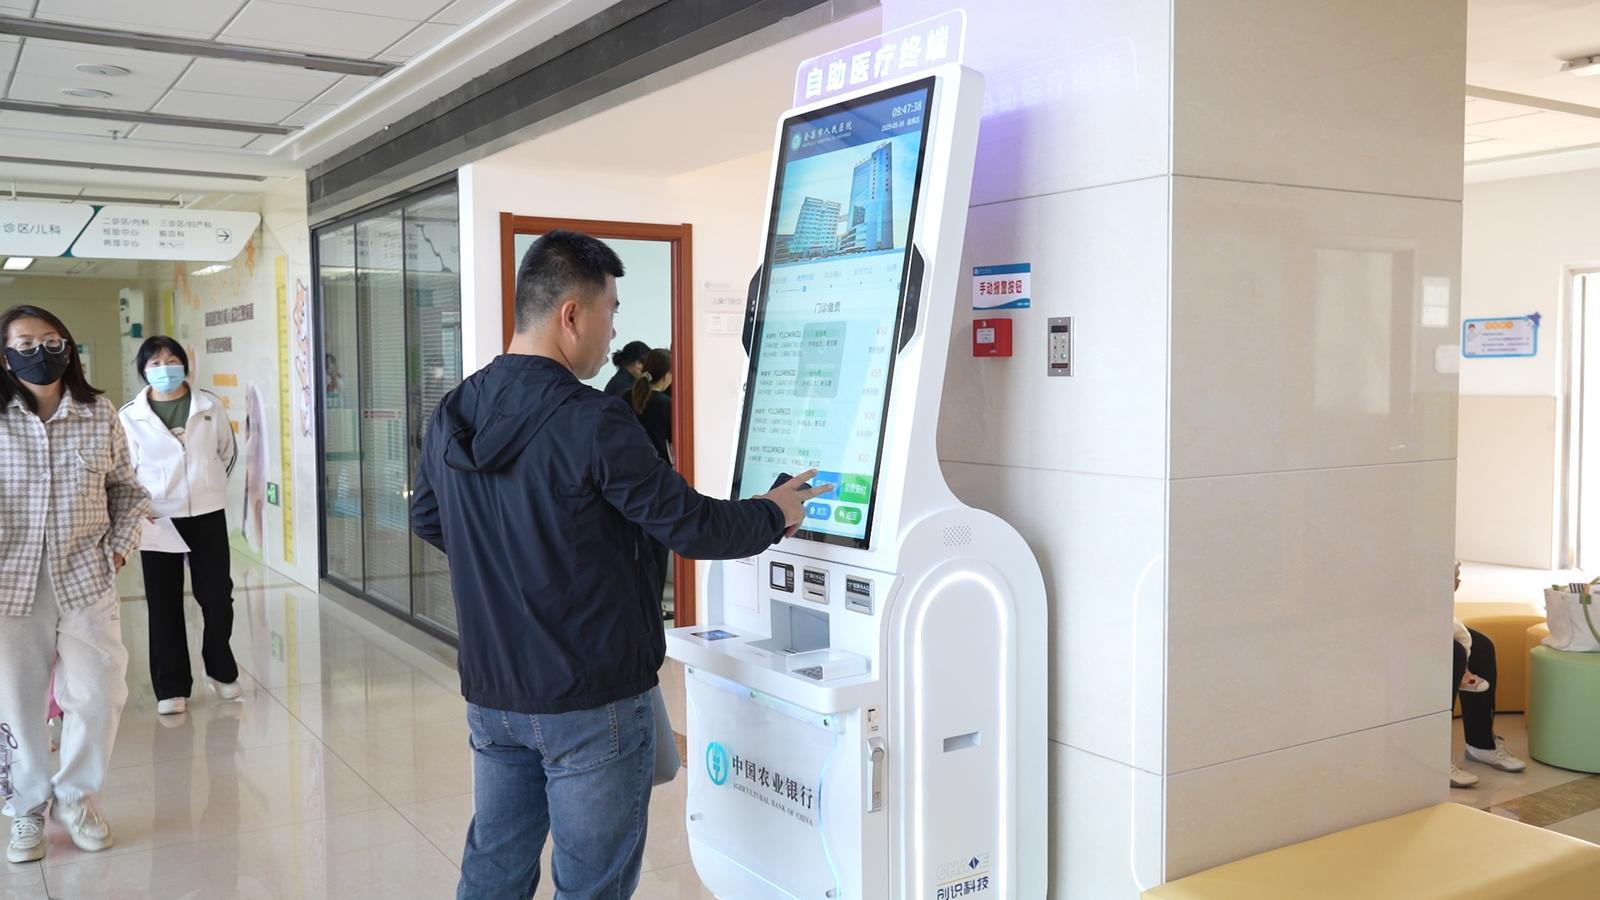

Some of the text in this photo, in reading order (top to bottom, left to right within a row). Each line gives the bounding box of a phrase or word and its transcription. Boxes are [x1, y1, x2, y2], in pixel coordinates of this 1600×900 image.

[804, 25, 950, 99] 自助医疗终端
[3, 222, 60, 234] 诊区/儿科
[102, 216, 149, 227] 二诊区/内科
[980, 280, 1023, 296] 手动报警按钮
[732, 755, 813, 809] 中国农业银行
[733, 782, 814, 827] AGRICULTURAL BANK OF CHINA
[937, 876, 990, 900] 创识科技
